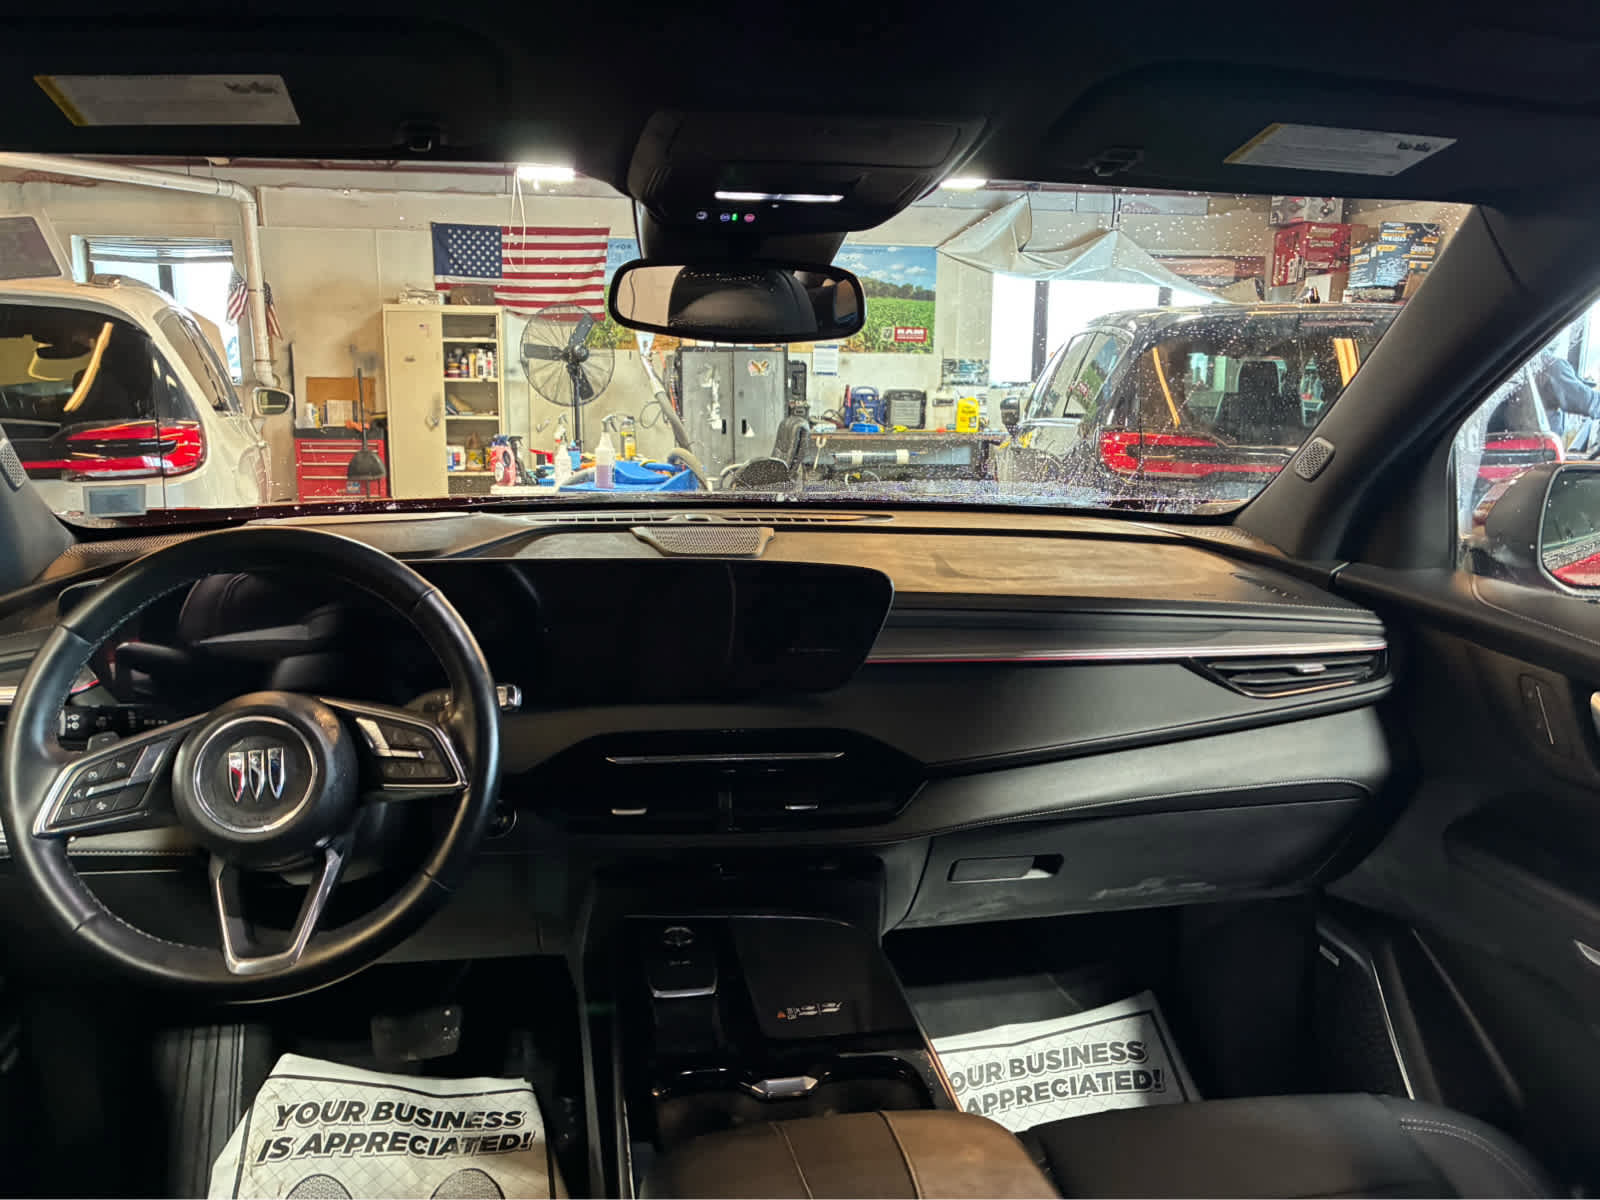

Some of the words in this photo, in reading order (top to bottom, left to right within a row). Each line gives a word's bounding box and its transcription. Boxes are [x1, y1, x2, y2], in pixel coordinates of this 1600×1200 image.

[897, 328, 925, 336] RAM
[950, 1061, 1004, 1093] OUR
[1008, 1041, 1148, 1079] BUSINESS
[965, 1068, 1165, 1116] APPRECIATED!
[274, 1100, 367, 1130] YOUR
[370, 1101, 527, 1130] BUSINESS
[255, 1136, 294, 1163] IS
[296, 1130, 535, 1157] APPRECIATED!
